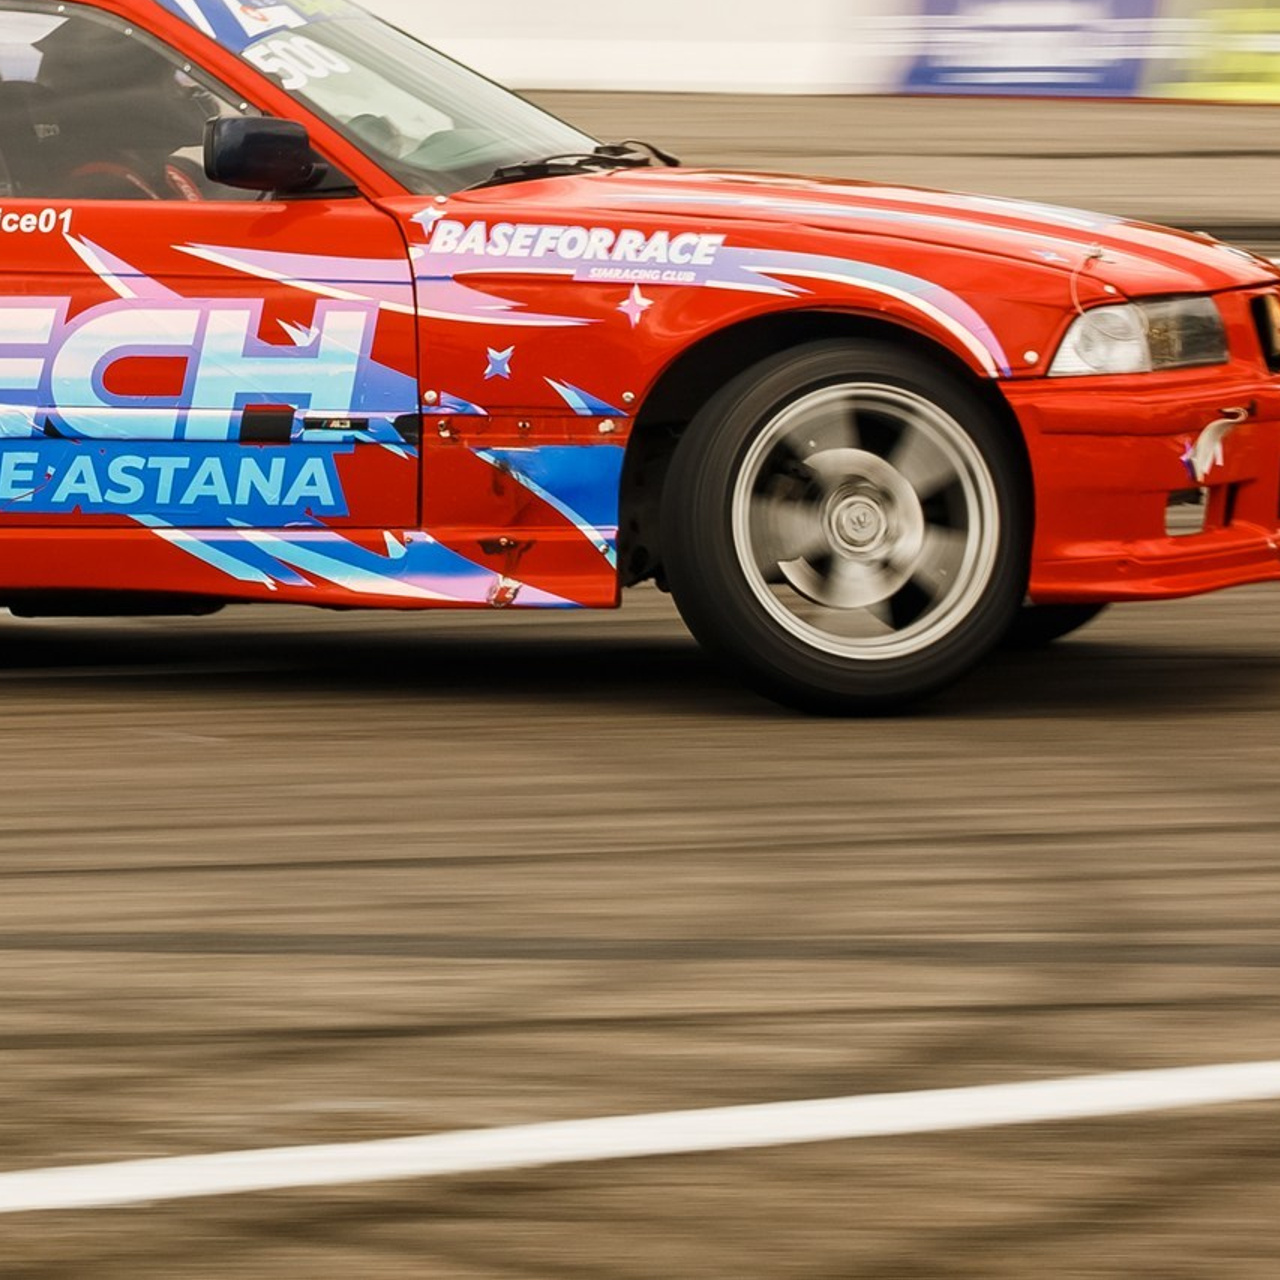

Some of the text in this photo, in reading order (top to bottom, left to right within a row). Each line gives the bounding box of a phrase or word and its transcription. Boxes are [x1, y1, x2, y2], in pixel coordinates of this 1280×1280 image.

[242, 36, 351, 91] 500
[661, 270, 697, 283] CLUB
[52, 454, 335, 507] ASTANA
